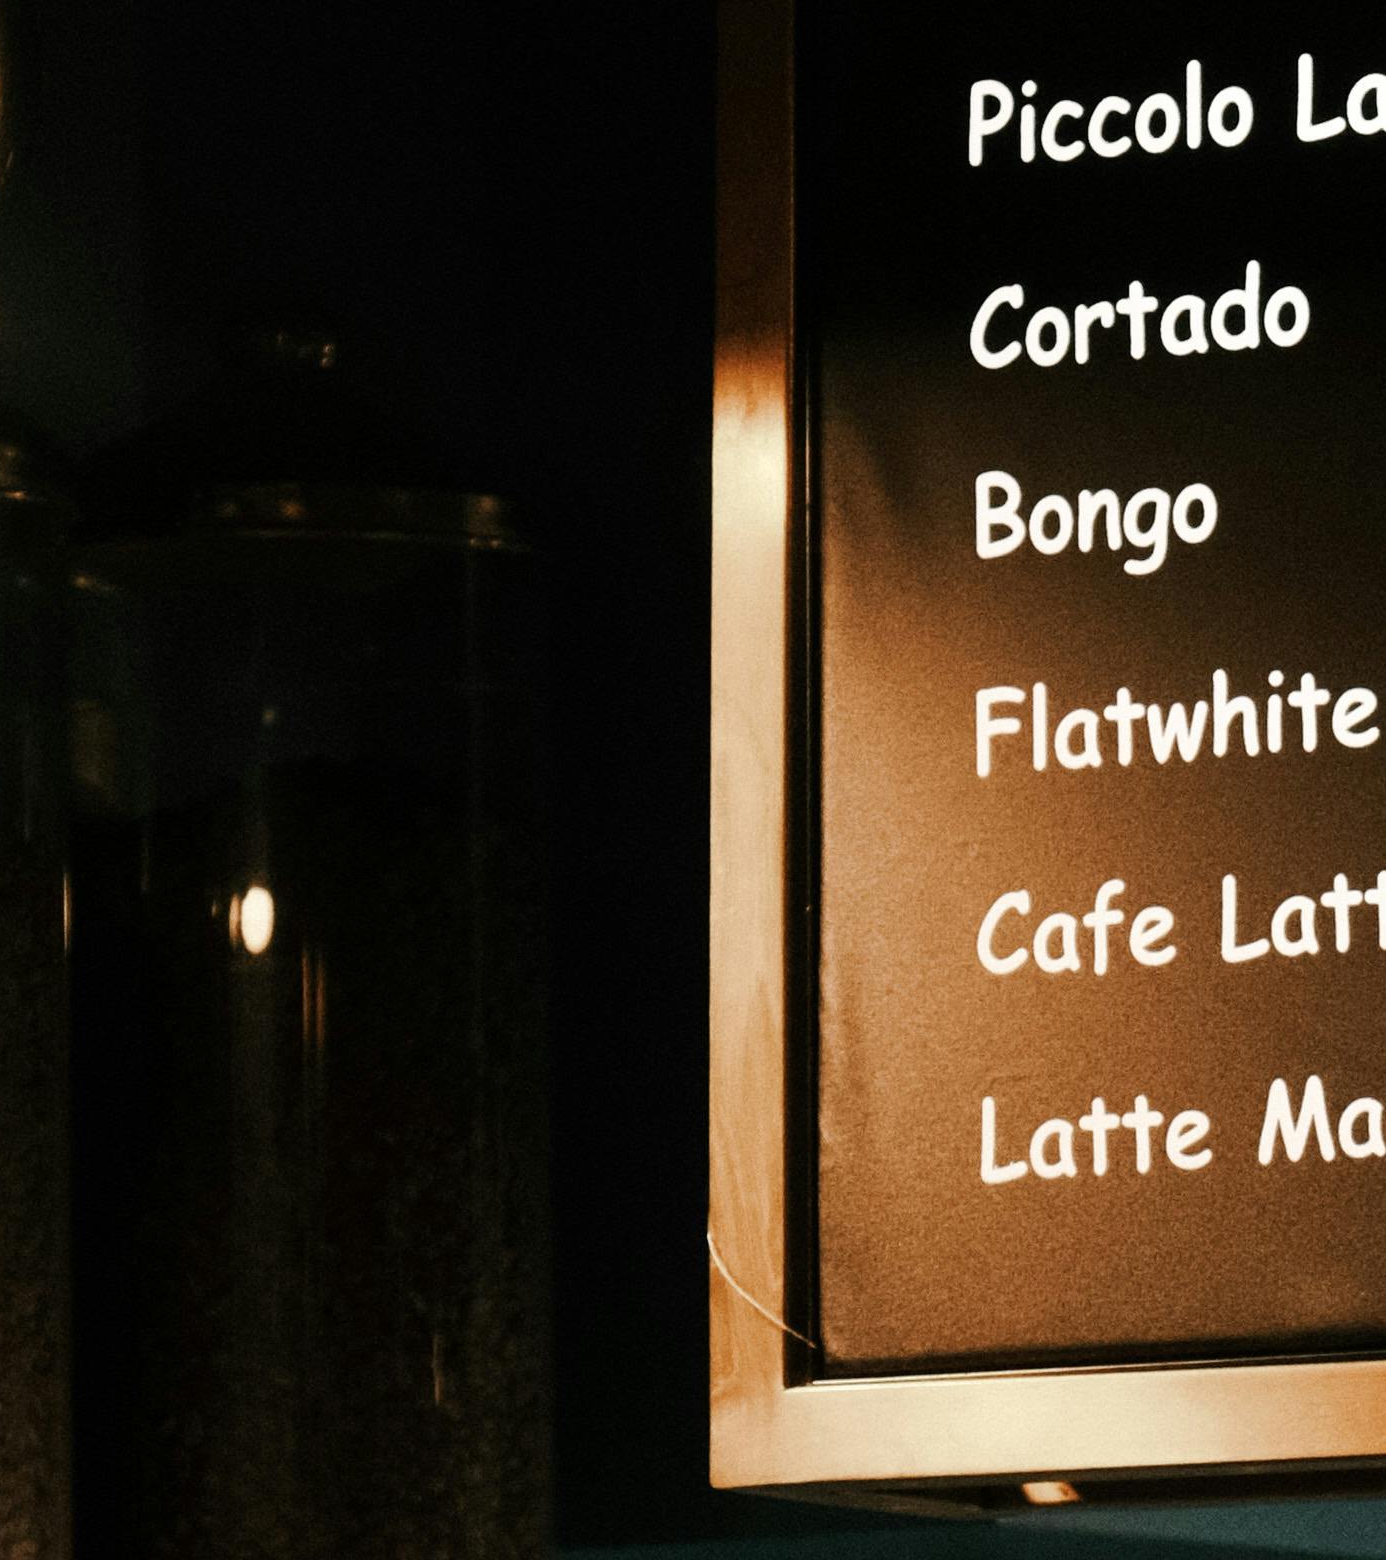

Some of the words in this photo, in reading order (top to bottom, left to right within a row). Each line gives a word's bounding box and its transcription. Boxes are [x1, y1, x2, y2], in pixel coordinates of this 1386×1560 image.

[967, 58, 1255, 168] Piccolo
[968, 258, 1312, 371] Cortado
[974, 469, 1219, 577] Bongo
[974, 667, 1381, 780] Flatwhite
[975, 877, 1179, 978] Cafe
[978, 1092, 1214, 1187] Latte
